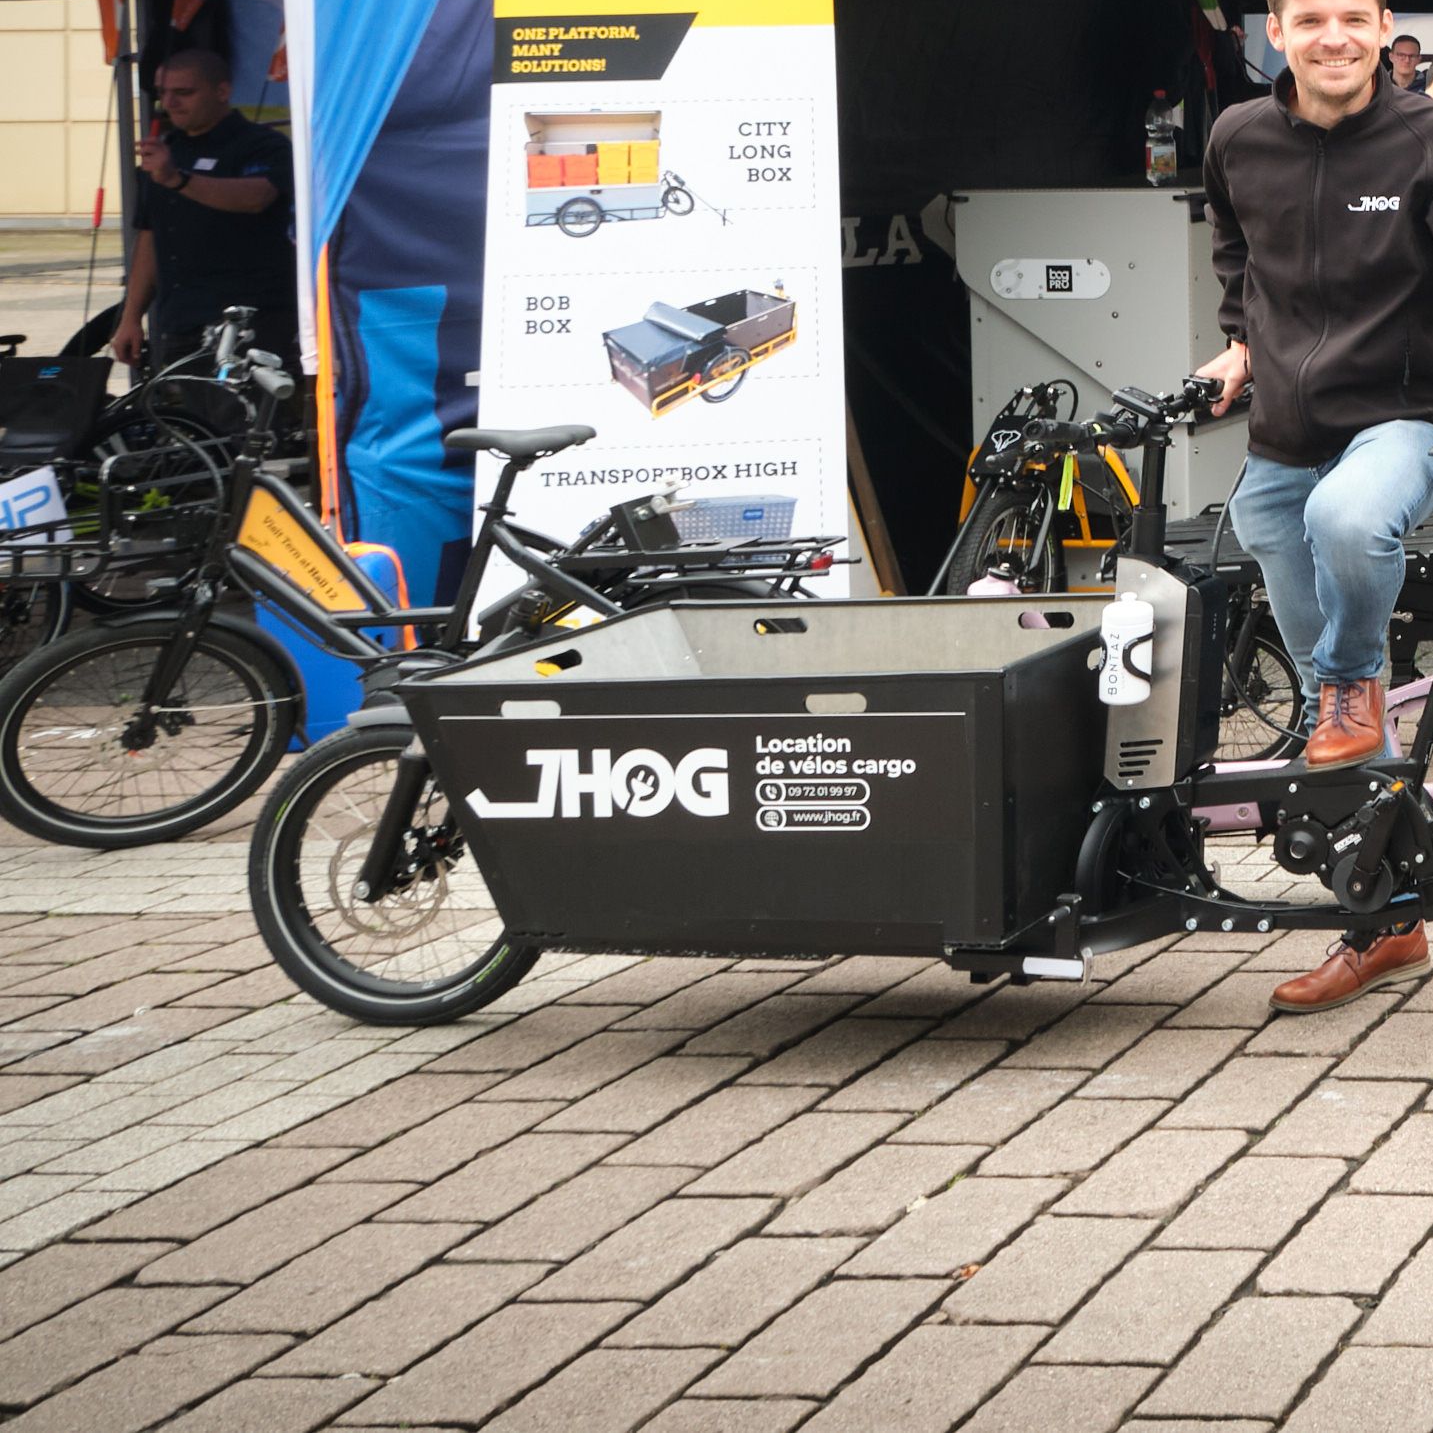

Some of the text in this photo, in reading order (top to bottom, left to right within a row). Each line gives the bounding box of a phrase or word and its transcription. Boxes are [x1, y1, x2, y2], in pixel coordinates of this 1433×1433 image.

[512, 26, 640, 41] ONE PLATFORM,
[512, 44, 562, 57] MANY
[511, 59, 606, 73] SOLUTIONS!
[738, 122, 792, 137] CITY
[729, 144, 792, 160] LONG
[747, 167, 792, 183] BOX
[1347, 196, 1400, 212] JHOG
[526, 296, 571, 311] BOB
[525, 319, 572, 335] BOX
[734, 461, 798, 479] HIGH
[263, 515, 283, 538] Visit
[308, 566, 328, 589] Hall
[325, 587, 338, 601] 12
[1107, 633, 1119, 696] BONTAZ
[756, 734, 851, 753] Location
[756, 756, 916, 778] de vélos cargo
[465, 748, 729, 817] JHOG
[788, 786, 857, 797] 09 72 01 99 97
[793, 811, 861, 824] www.jhog.fr
